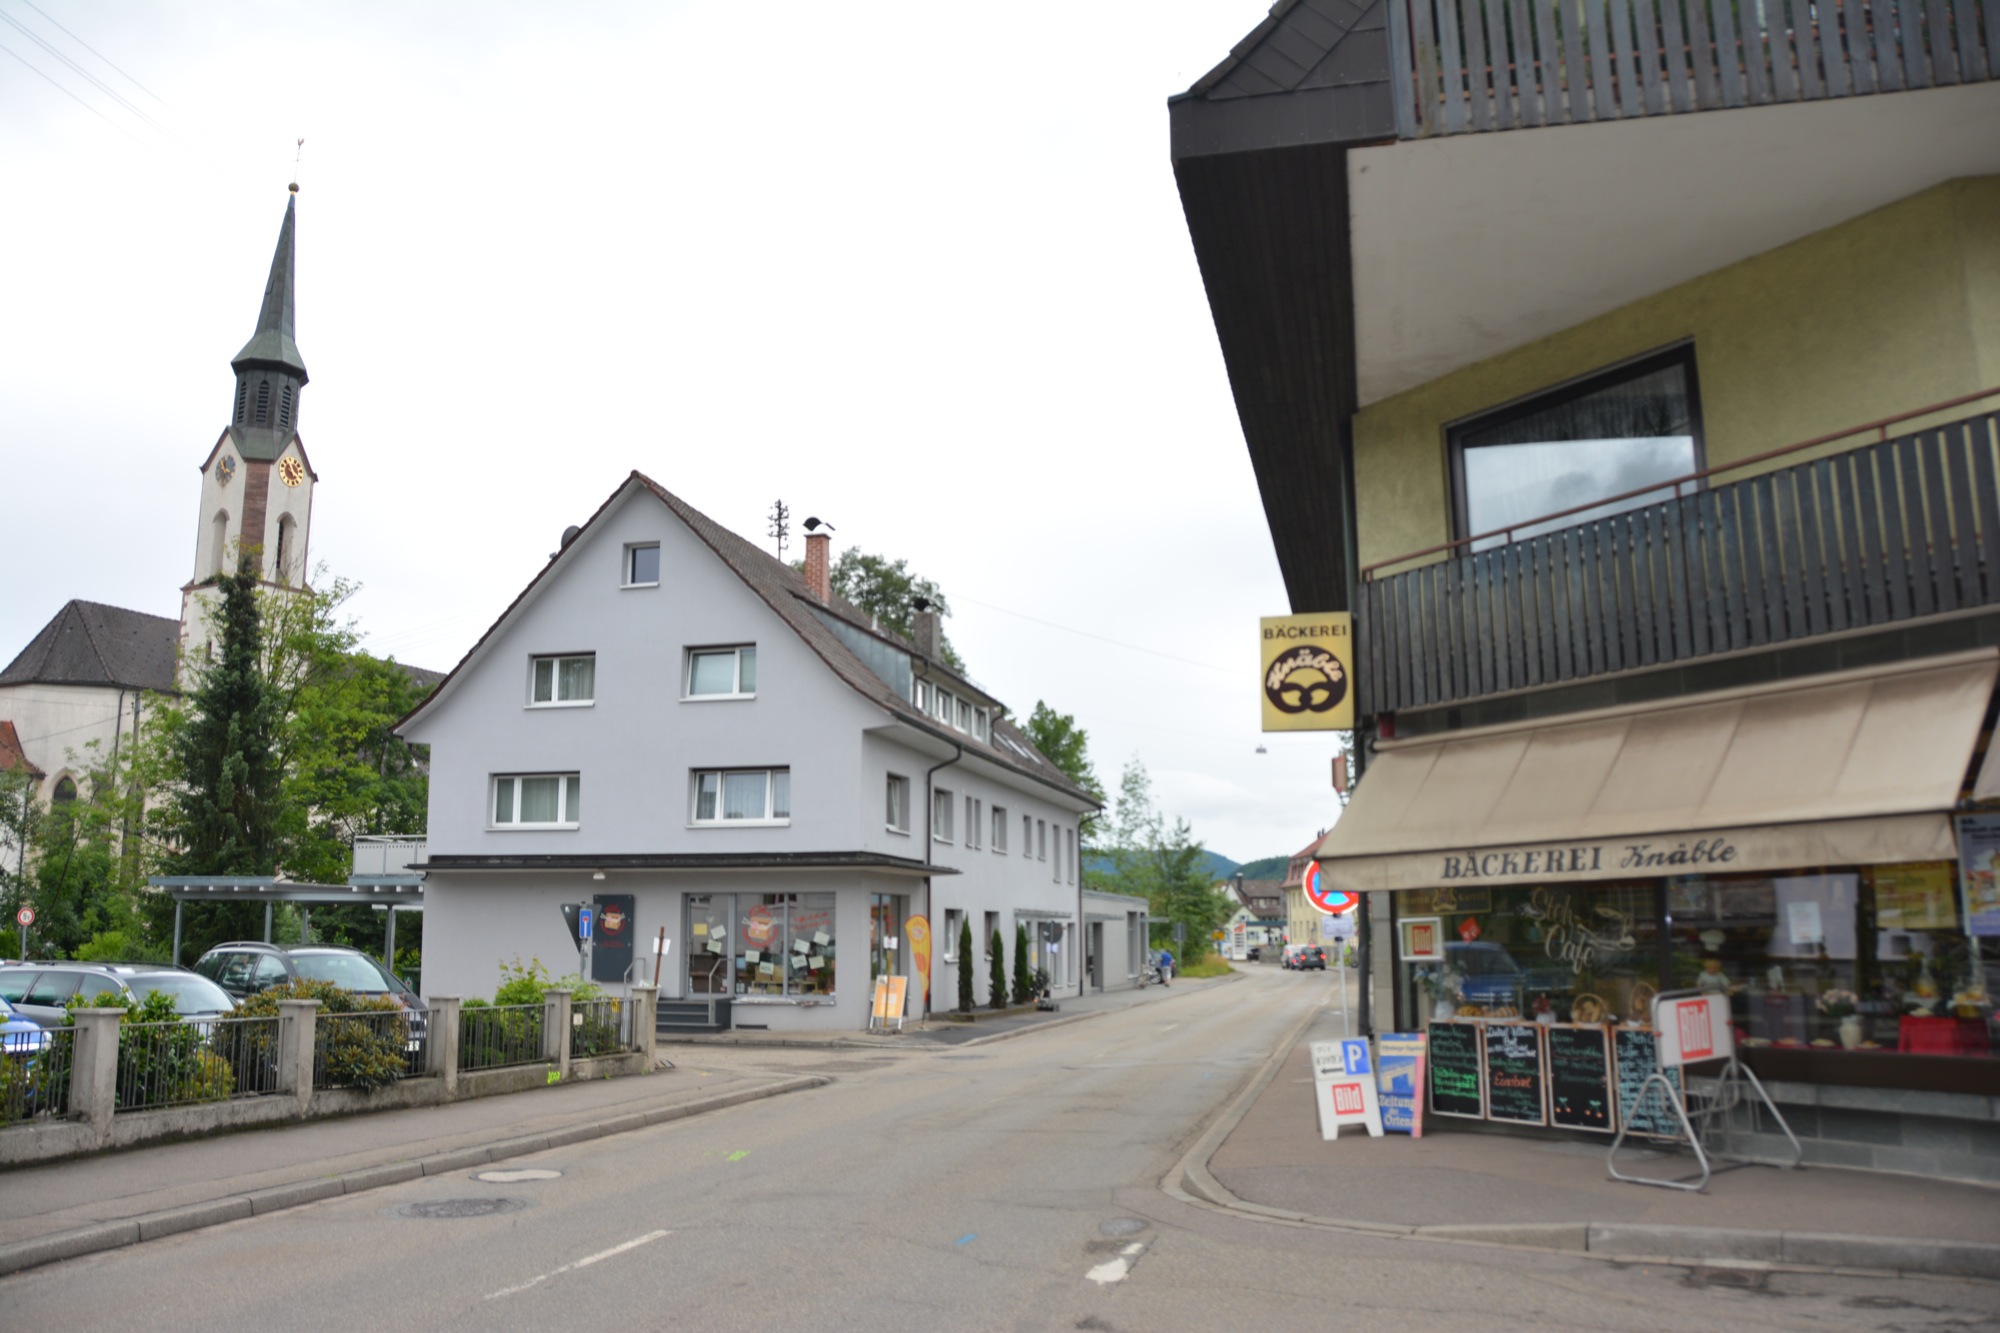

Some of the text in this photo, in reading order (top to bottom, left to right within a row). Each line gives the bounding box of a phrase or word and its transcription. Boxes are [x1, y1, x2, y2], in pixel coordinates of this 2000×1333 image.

[1264, 624, 1346, 639] BÄCKEREI
[1266, 648, 1343, 690] Knäble
[1440, 837, 1737, 880] BÄCKEREI Knäble
[1678, 1005, 1711, 1053] Bild
[1348, 1044, 1363, 1072] P
[1335, 1087, 1362, 1111] Bild
[1379, 1095, 1416, 1111] Zeitung
